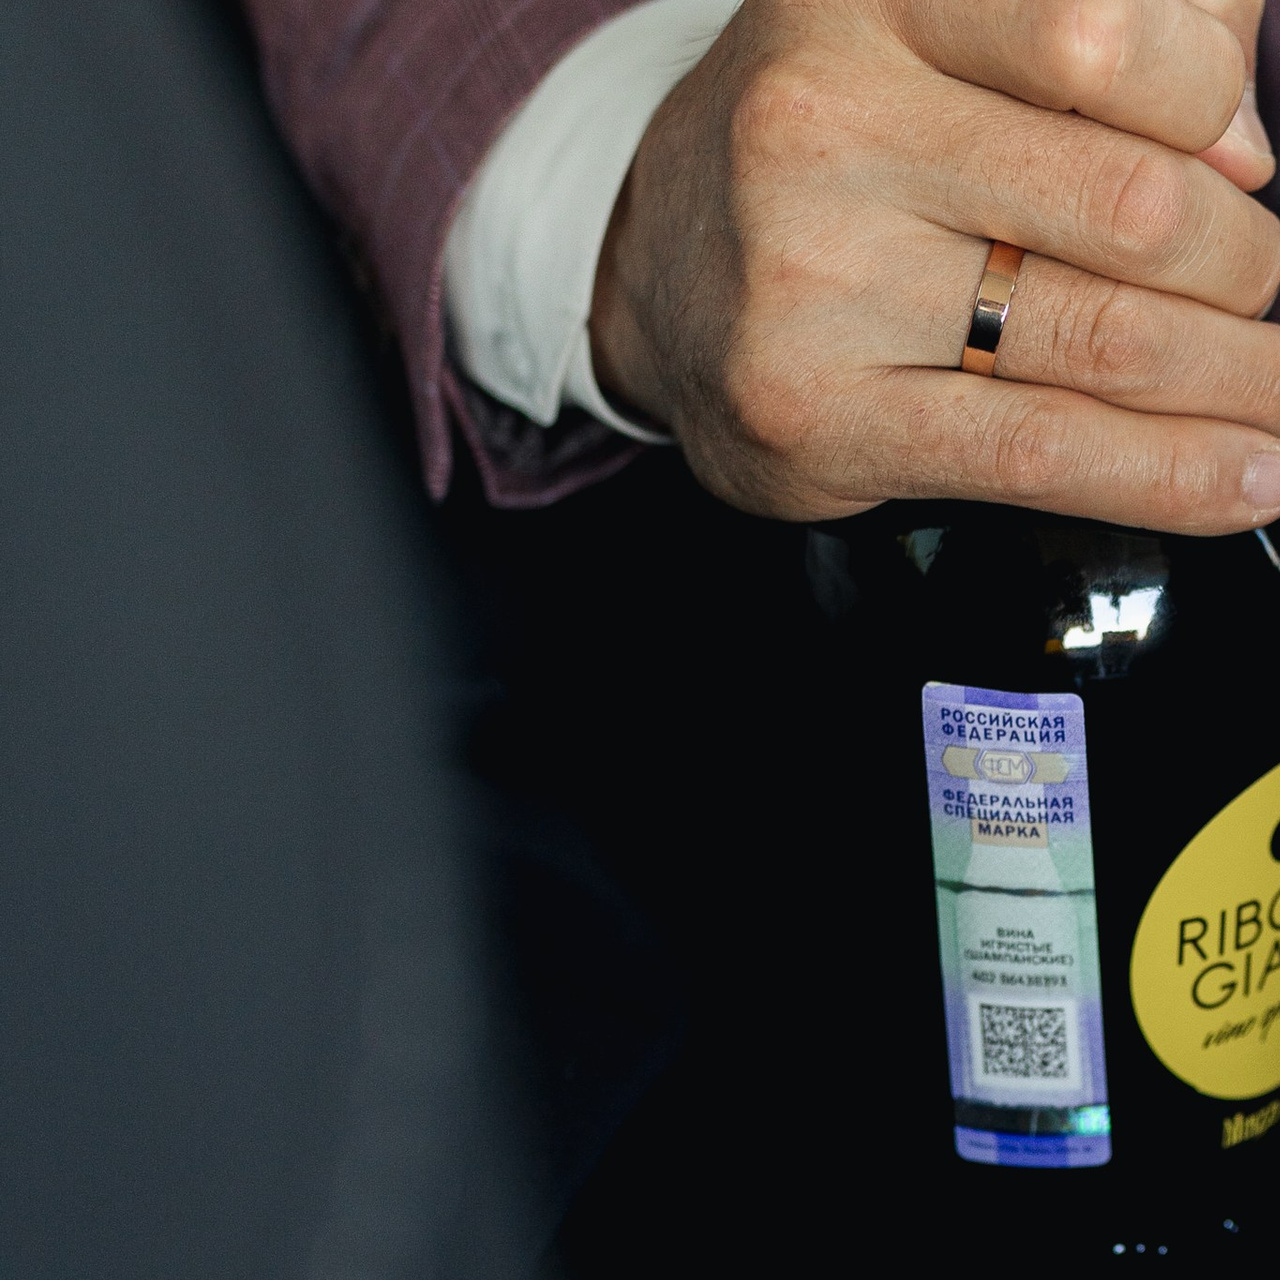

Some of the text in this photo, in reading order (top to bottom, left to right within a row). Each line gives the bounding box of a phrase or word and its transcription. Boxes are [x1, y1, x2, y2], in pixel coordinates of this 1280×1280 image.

[940, 707, 1066, 729] РОССИЙСКАЯ
[941, 723, 1066, 744] ФЕДЕРАЦИЯ
[943, 789, 1074, 809] ФЕДЕРАЛЬНАЯ
[943, 804, 1075, 824] СПЕЦИАЛЬНАЯ
[978, 823, 1041, 838] МАРКА
[996, 927, 1034, 939] ВИНА
[980, 939, 1053, 953] ИГРИСТЫЕ
